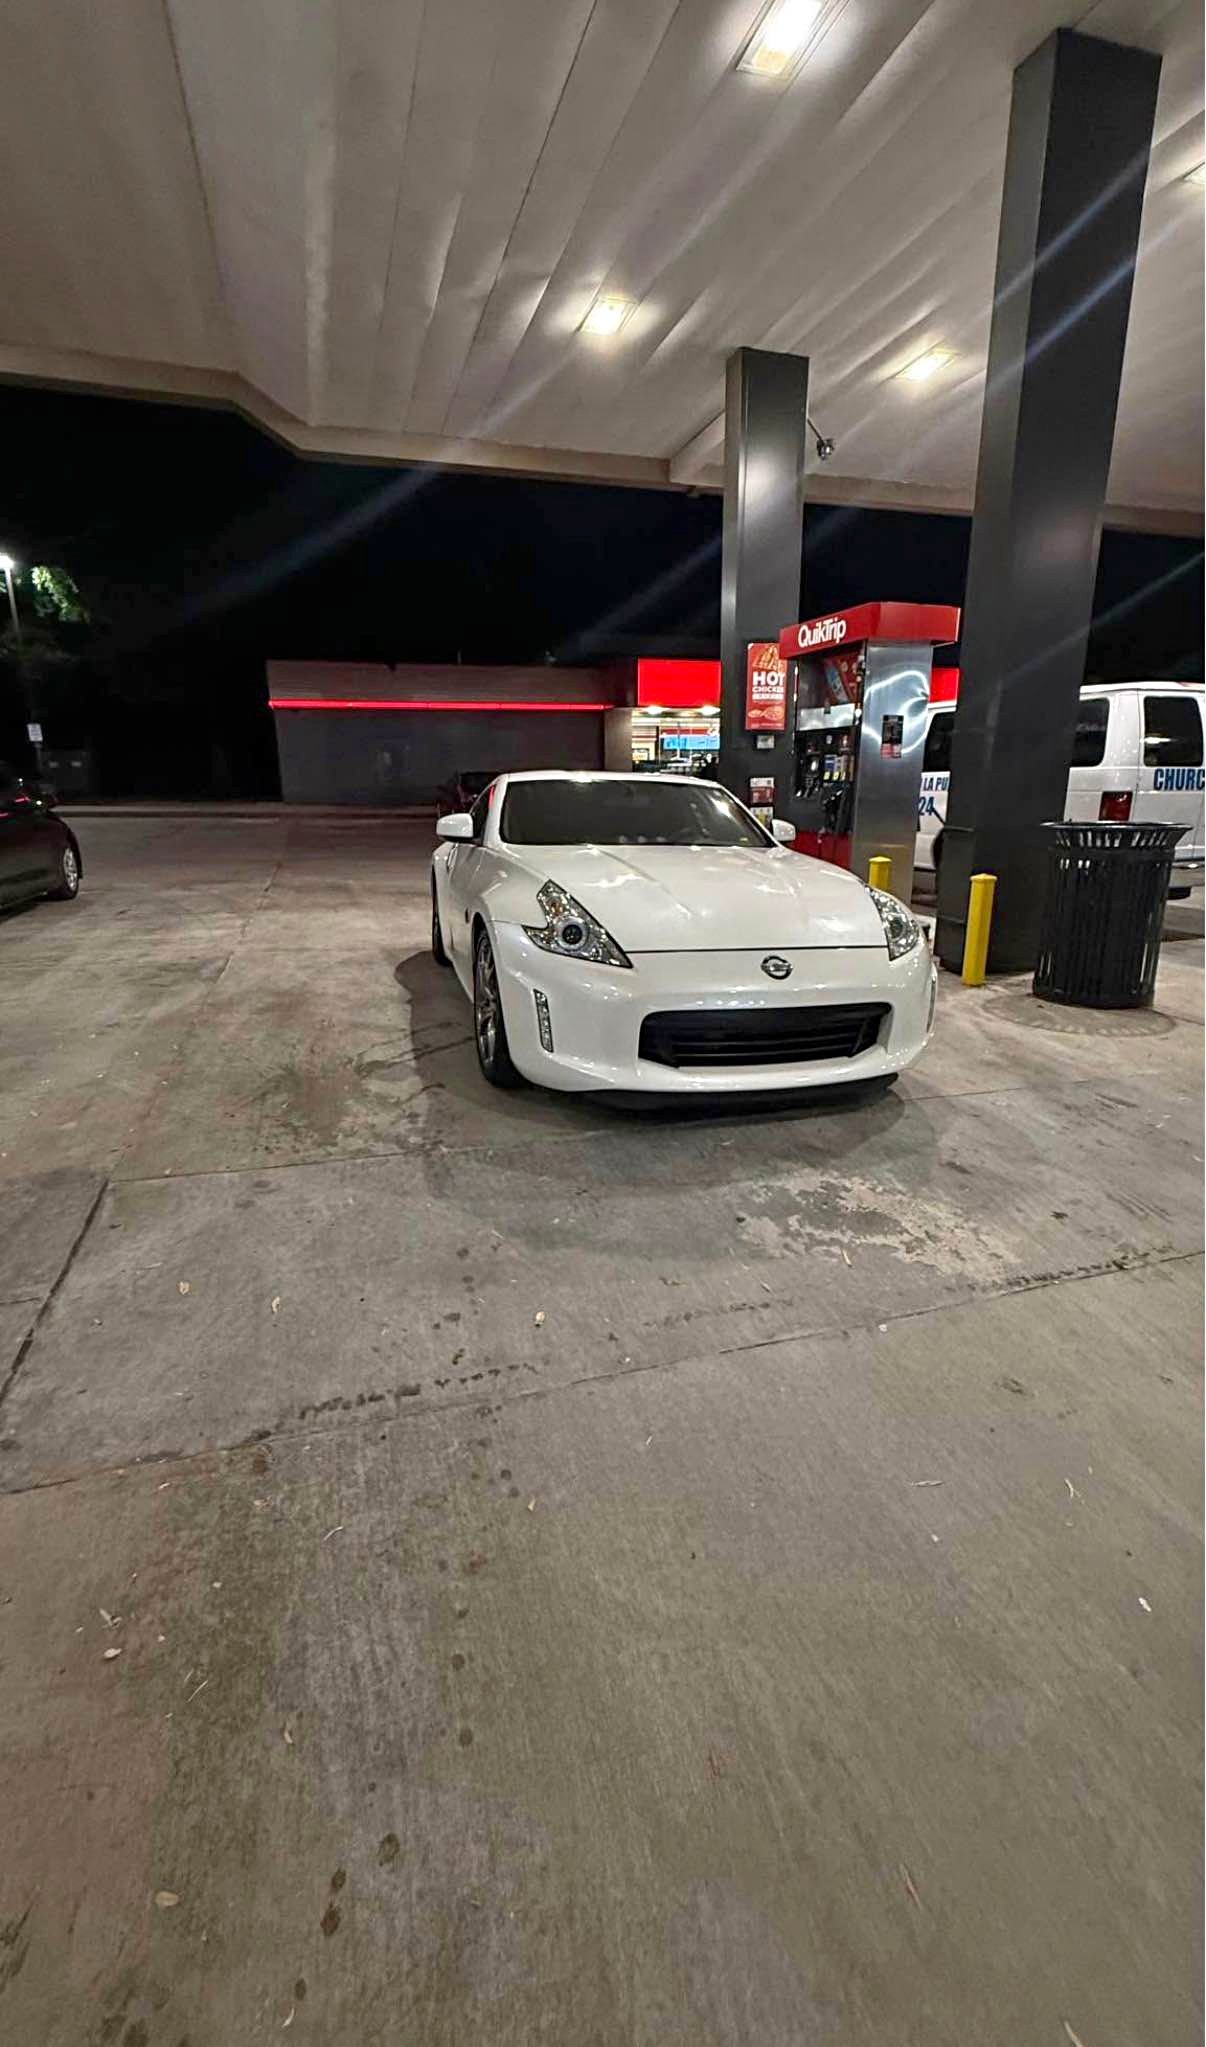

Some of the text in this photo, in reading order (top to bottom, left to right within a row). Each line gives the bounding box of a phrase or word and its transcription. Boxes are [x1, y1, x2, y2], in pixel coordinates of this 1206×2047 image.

[798, 617, 846, 648] QuikTrip
[753, 671, 786, 686] HOT
[923, 777, 934, 791] LA
[1153, 768, 1205, 791] CHURC
[919, 796, 934, 816] 24
